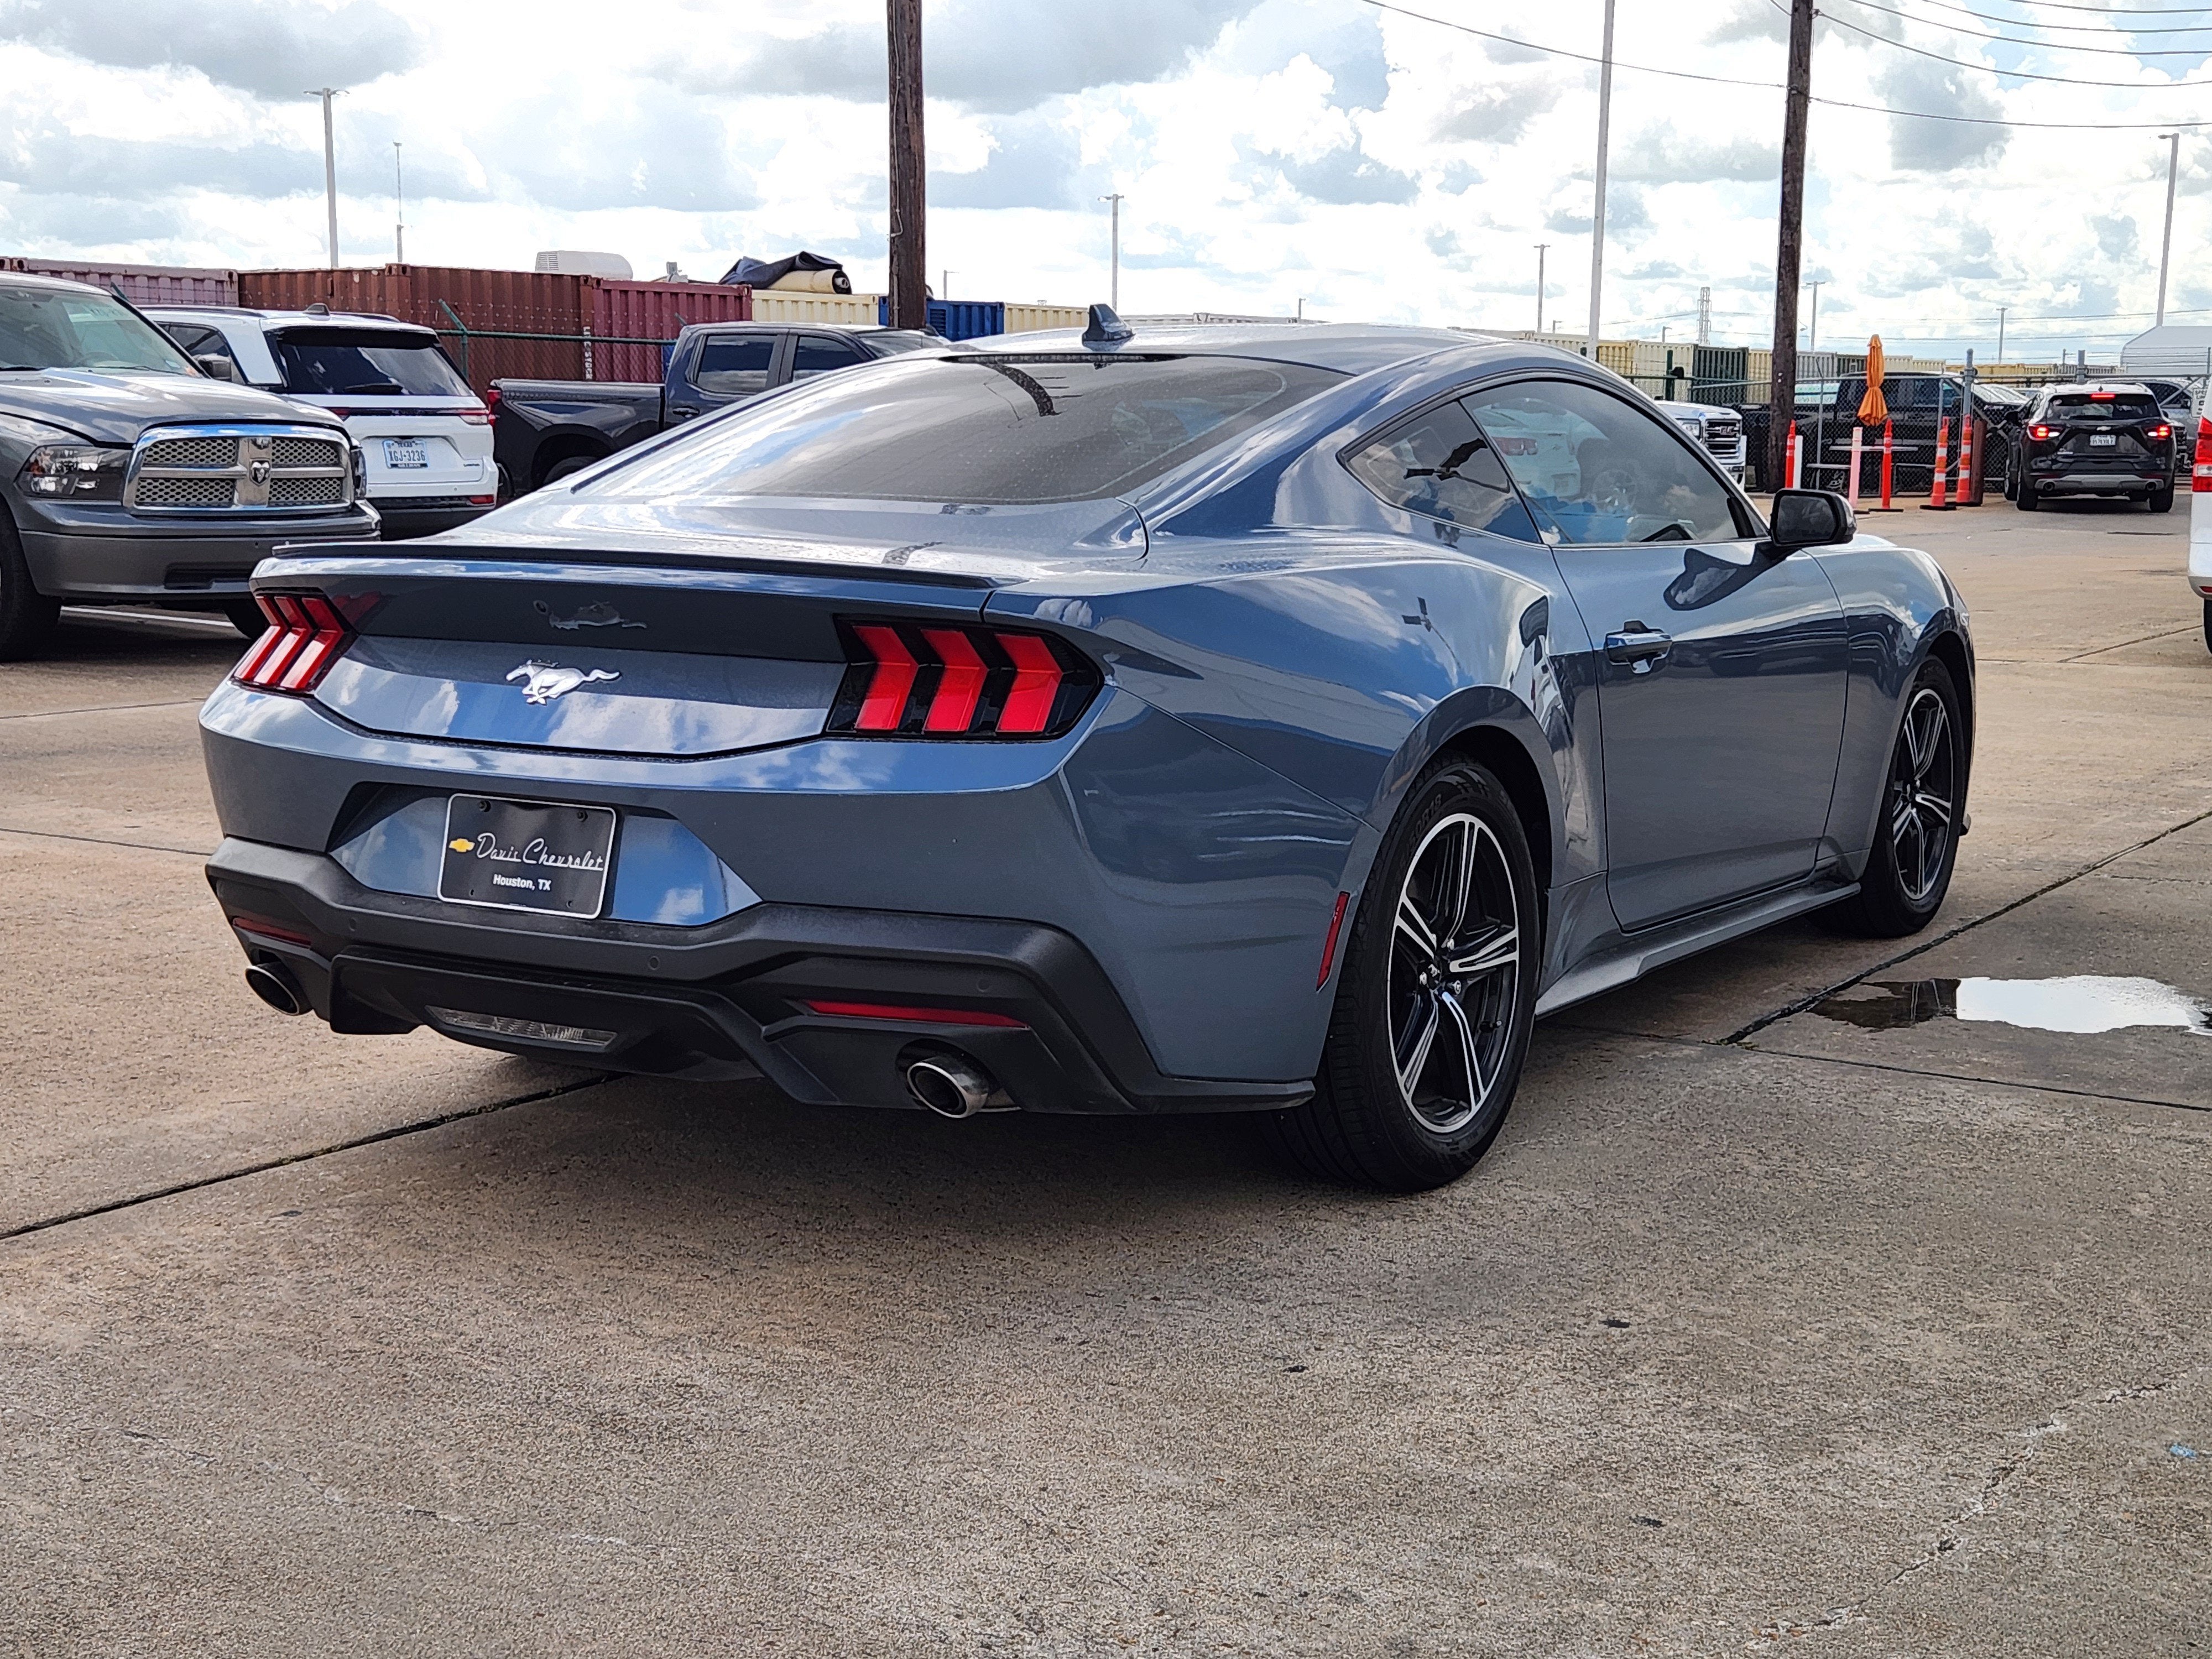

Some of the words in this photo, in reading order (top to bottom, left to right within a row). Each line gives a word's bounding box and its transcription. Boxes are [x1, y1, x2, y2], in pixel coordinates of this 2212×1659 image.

[476, 832, 521, 862] Davis
[523, 838, 603, 872] Chevrolet
[492, 874, 536, 891] Houston,
[538, 879, 552, 891] TX
